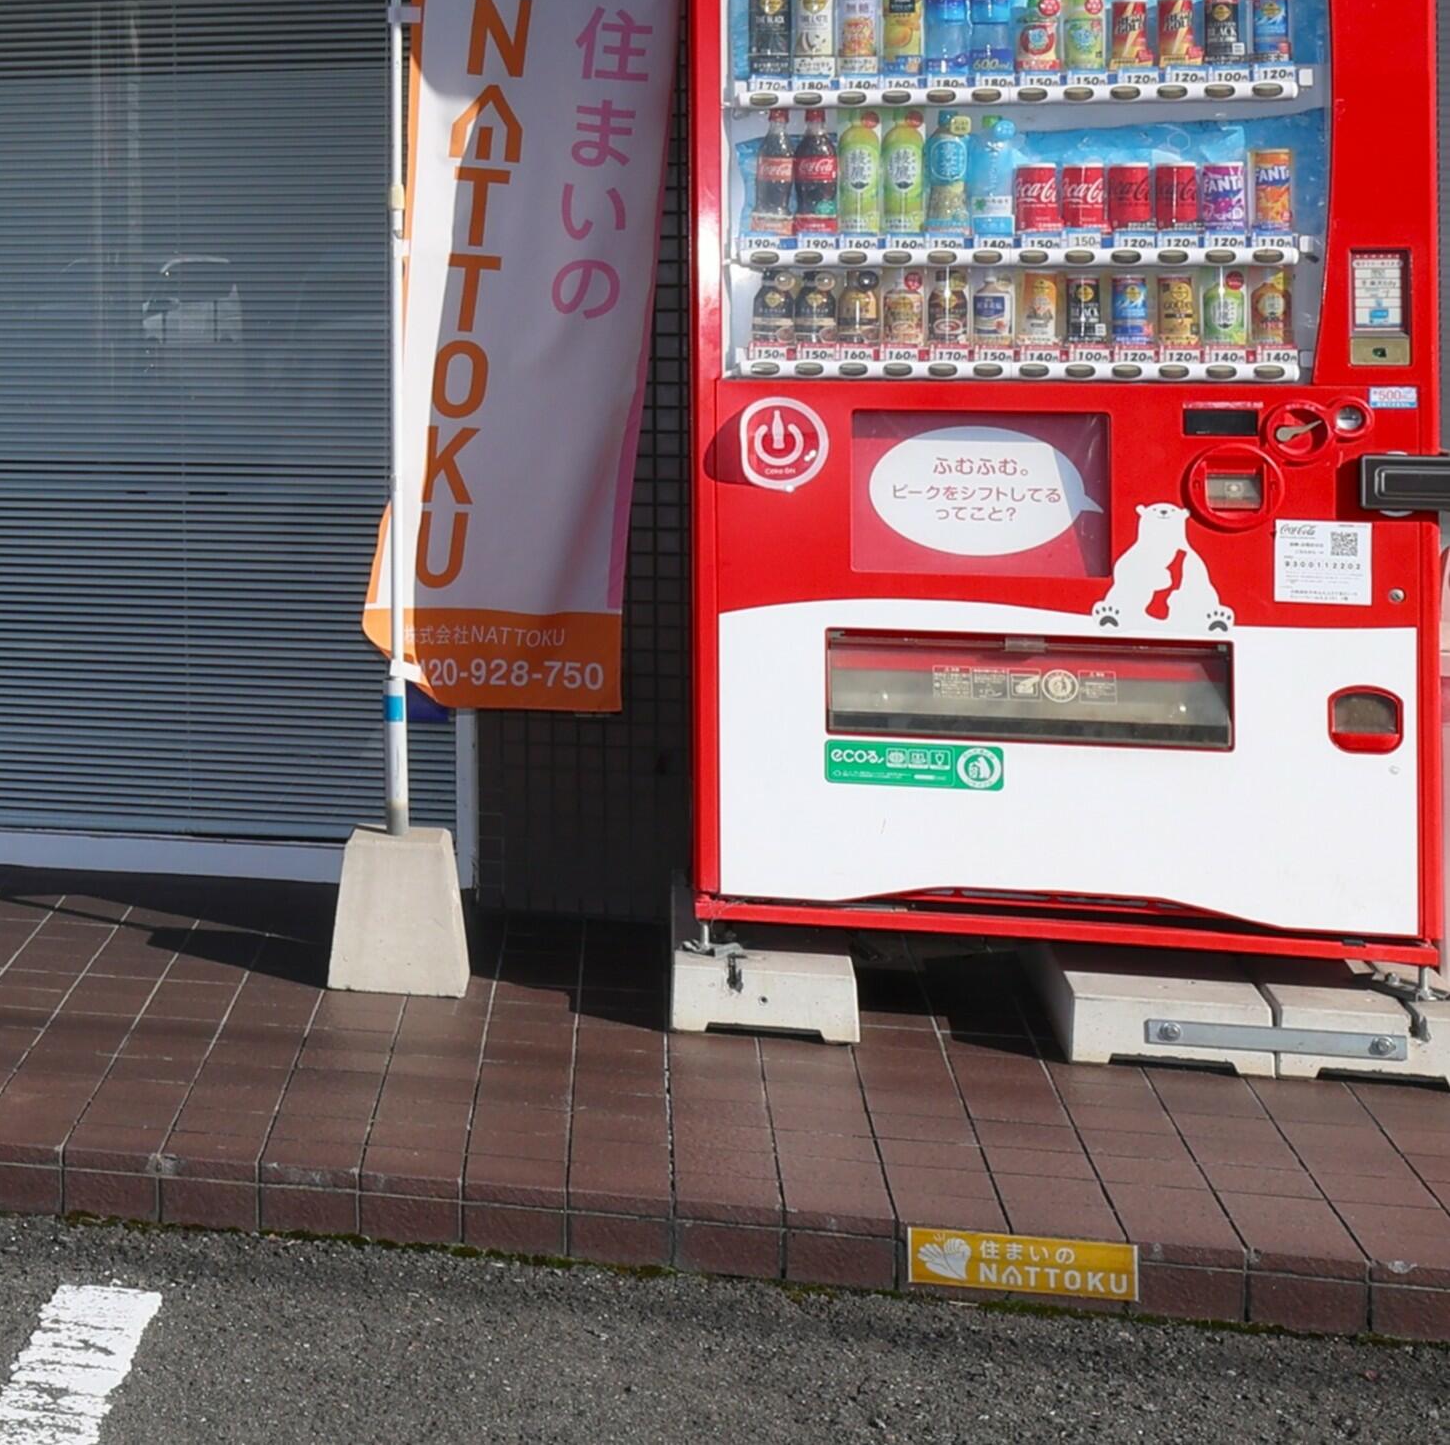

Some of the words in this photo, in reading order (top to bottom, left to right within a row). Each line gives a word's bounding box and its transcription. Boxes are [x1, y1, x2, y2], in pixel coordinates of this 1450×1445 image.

[551, 6, 655, 320] 住まいの
[932, 457, 1029, 476] ふむふむ。
[420, 657, 605, 691] 20-928-750
[979, 1239, 1076, 1265] 住まいの
[979, 1262, 1128, 1294] NATTOKU
